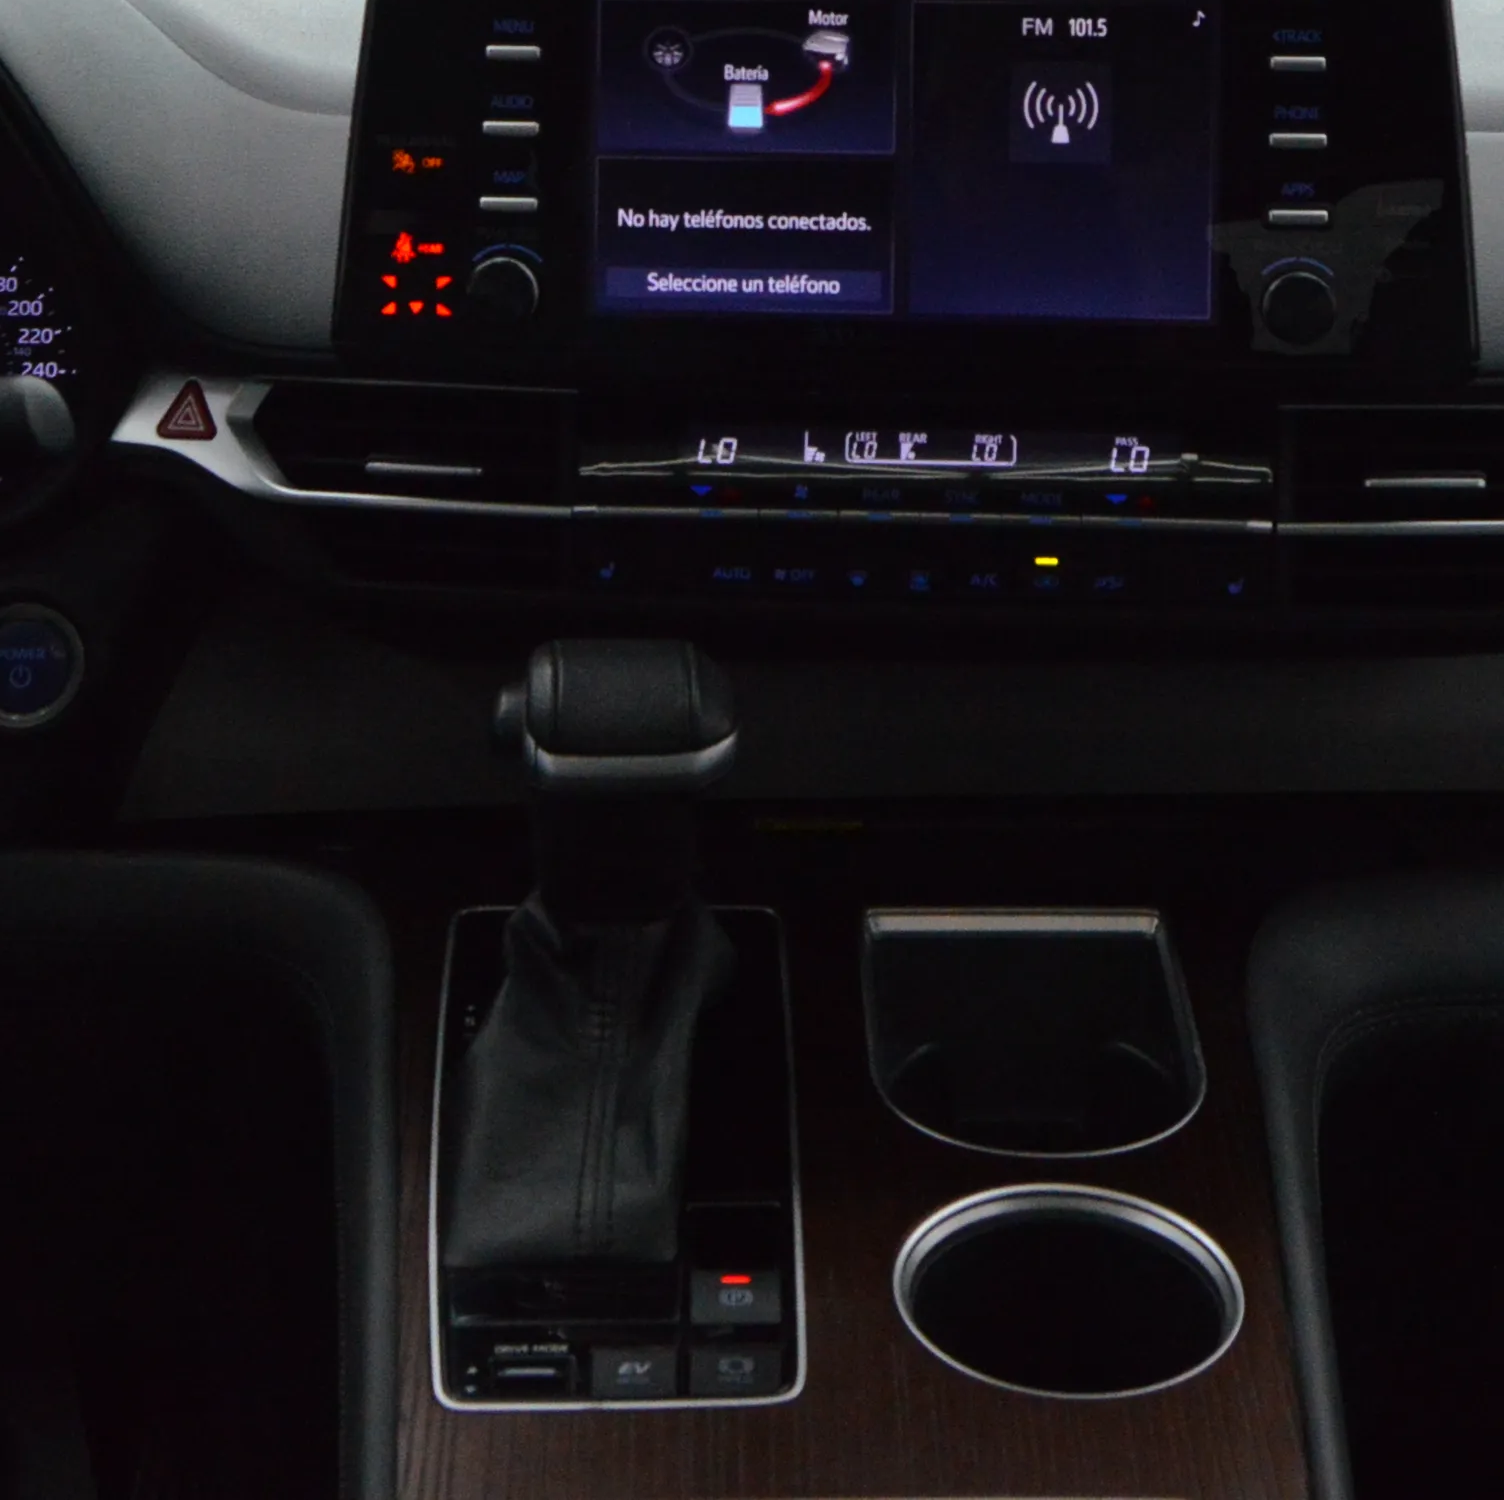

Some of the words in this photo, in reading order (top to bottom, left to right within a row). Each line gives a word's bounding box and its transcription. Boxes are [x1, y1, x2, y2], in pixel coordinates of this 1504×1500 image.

[809, 9, 849, 26] Motor
[493, 20, 534, 34] MENU
[1021, 17, 1053, 37] FM
[1068, 17, 1108, 38] 101.5
[724, 63, 769, 82] Batería
[490, 95, 533, 109] AUDIO
[1273, 106, 1320, 121] PHONE
[421, 156, 444, 169] OFF
[493, 171, 526, 184] MAP
[1280, 182, 1315, 197] APPS
[617, 208, 645, 228] No
[648, 208, 680, 233] hay
[683, 208, 764, 231] teléfonos
[767, 210, 872, 232] conectados.
[647, 272, 738, 294] Seleccione
[741, 278, 764, 294] un
[767, 274, 841, 296] teléfono
[8, 300, 44, 317] 200
[17, 327, 54, 345] 220
[21, 361, 58, 379] 240
[855, 431, 878, 443] LEFT
[898, 432, 928, 444] REAR
[974, 433, 1003, 445] RIGHT
[712, 566, 752, 582] AUTO
[493, 1343, 528, 1355] DRIVE
[532, 1343, 569, 1354] MODE
[617, 1360, 653, 1376] EV
